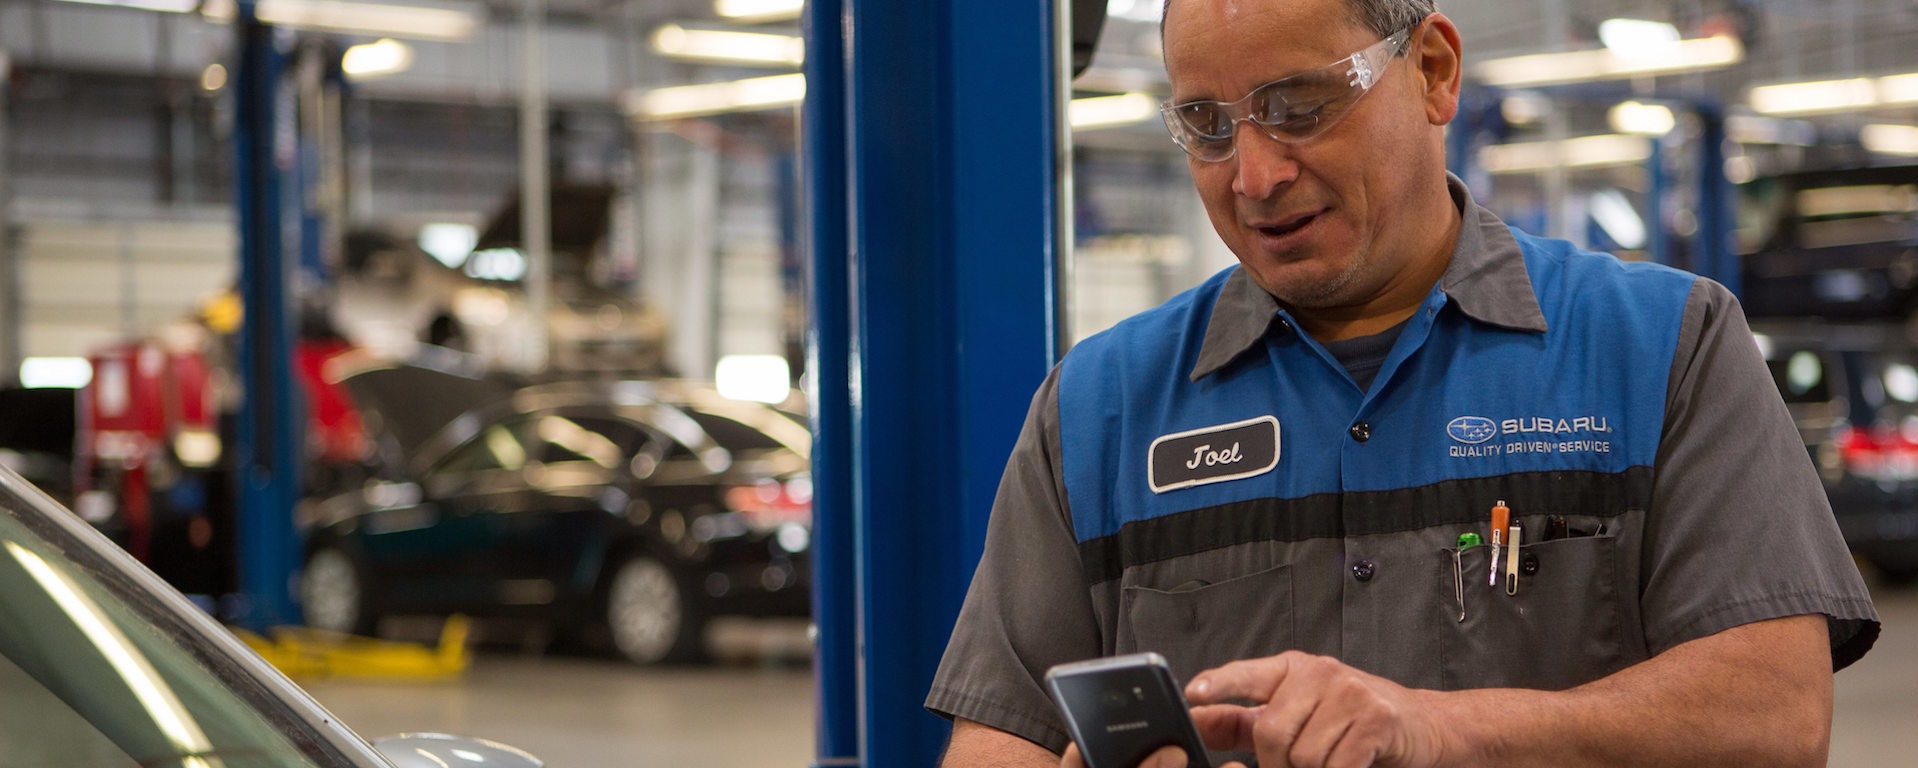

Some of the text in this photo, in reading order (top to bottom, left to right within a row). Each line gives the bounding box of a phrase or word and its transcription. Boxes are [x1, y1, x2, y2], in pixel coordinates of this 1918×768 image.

[1501, 416, 1607, 434] SUBARU
[1186, 441, 1243, 470] Joel
[1449, 440, 1610, 457] QUALITY DRIVEN SERVICE
